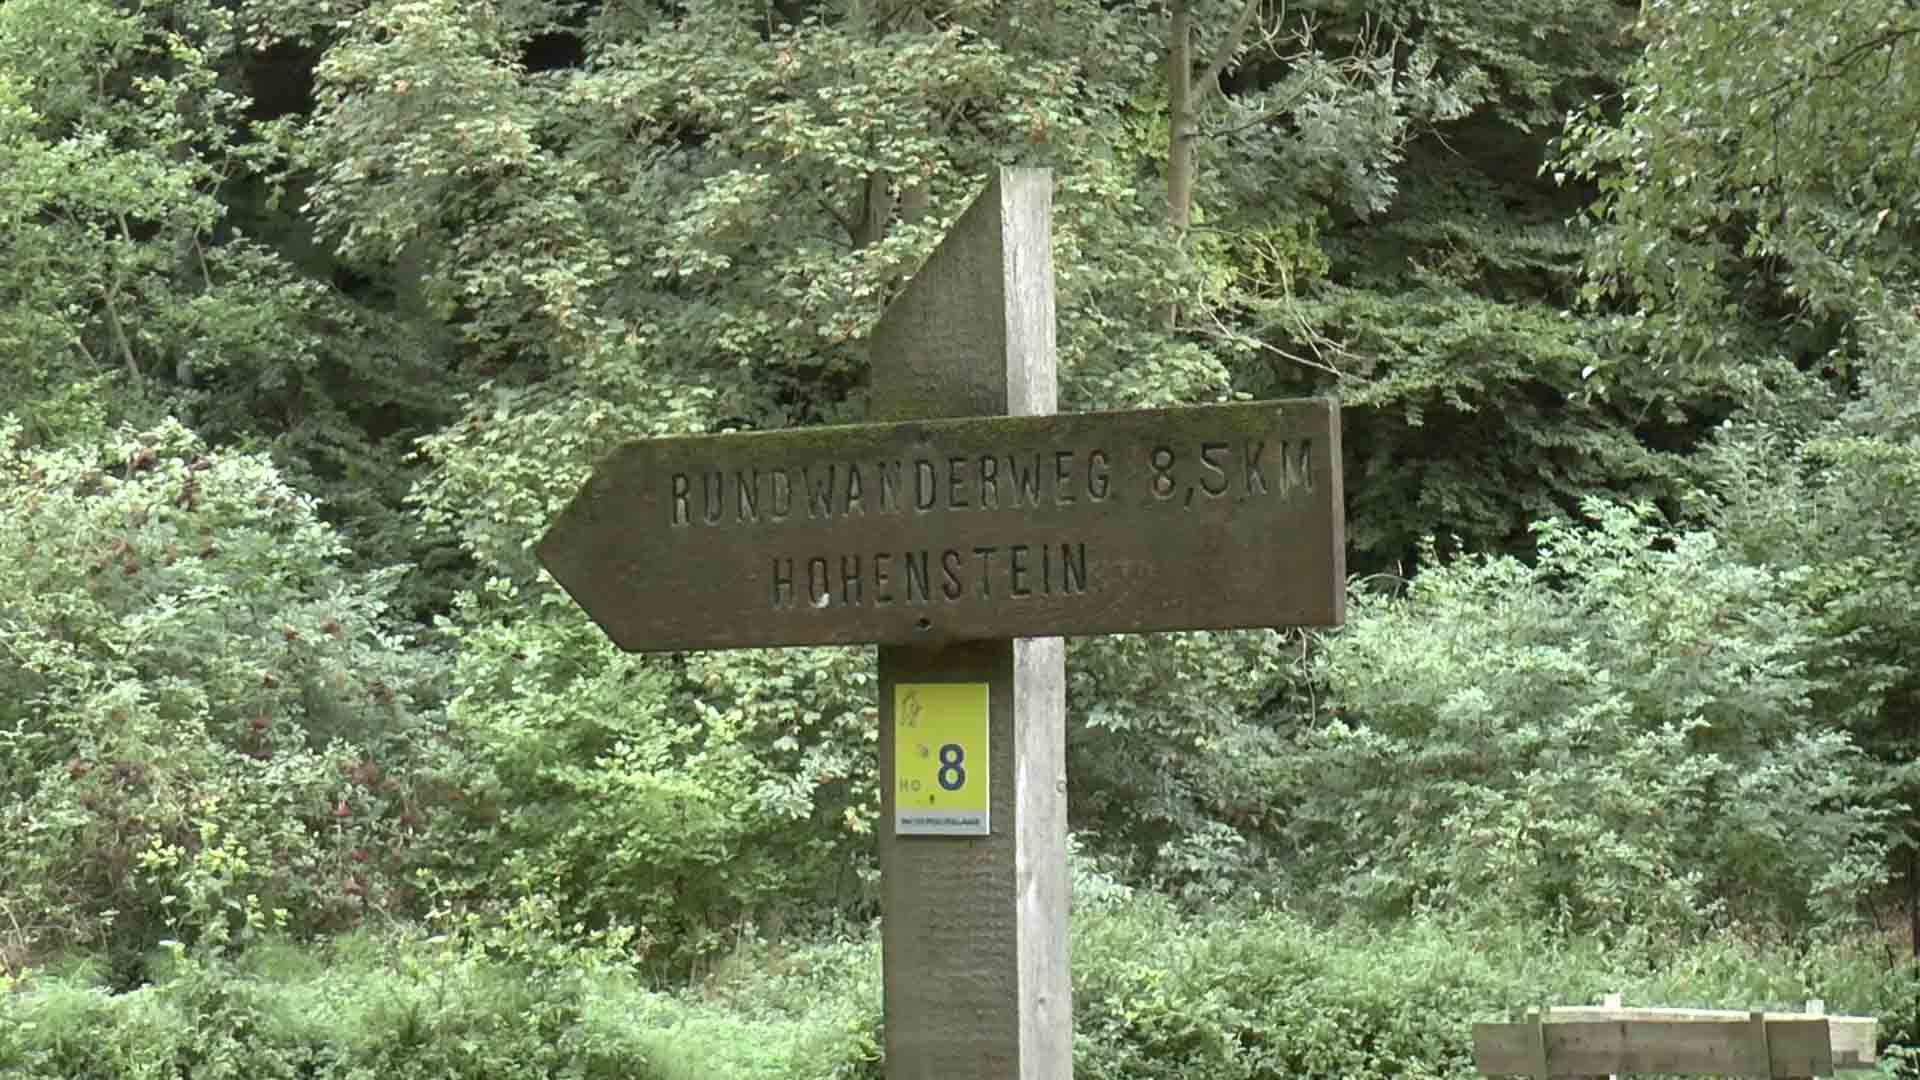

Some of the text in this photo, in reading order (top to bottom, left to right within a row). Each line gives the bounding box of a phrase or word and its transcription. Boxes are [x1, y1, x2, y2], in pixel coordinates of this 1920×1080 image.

[671, 449, 1112, 527] RUNDWANDERWEG
[771, 543, 1088, 607] HOHENSTEIN
[938, 743, 966, 791] 8
